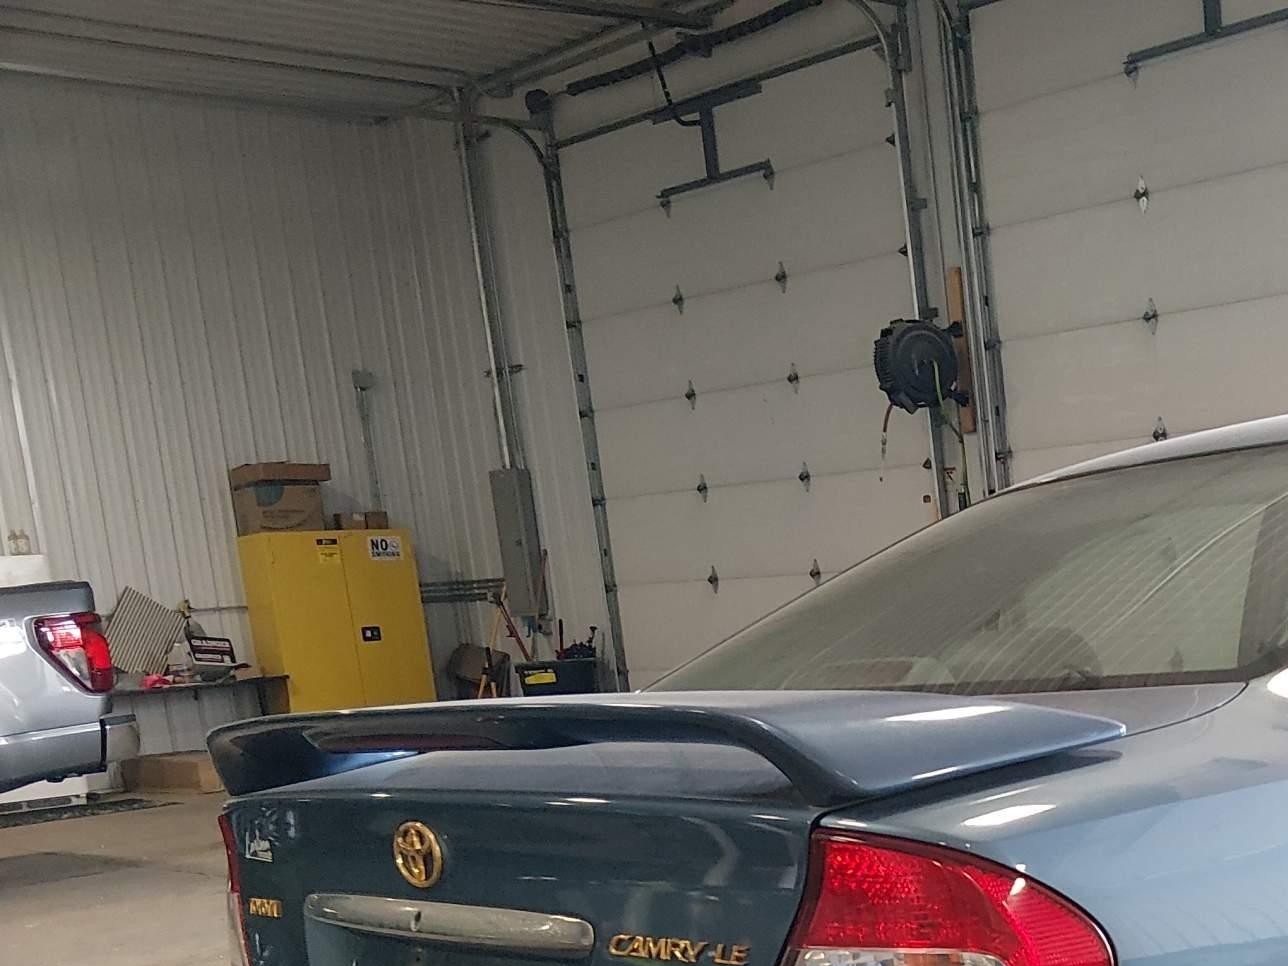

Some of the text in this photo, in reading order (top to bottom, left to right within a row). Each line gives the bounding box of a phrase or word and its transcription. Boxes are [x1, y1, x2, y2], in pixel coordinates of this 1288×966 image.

[370, 538, 389, 551] NO
[608, 933, 751, 966] CAMRY LE
